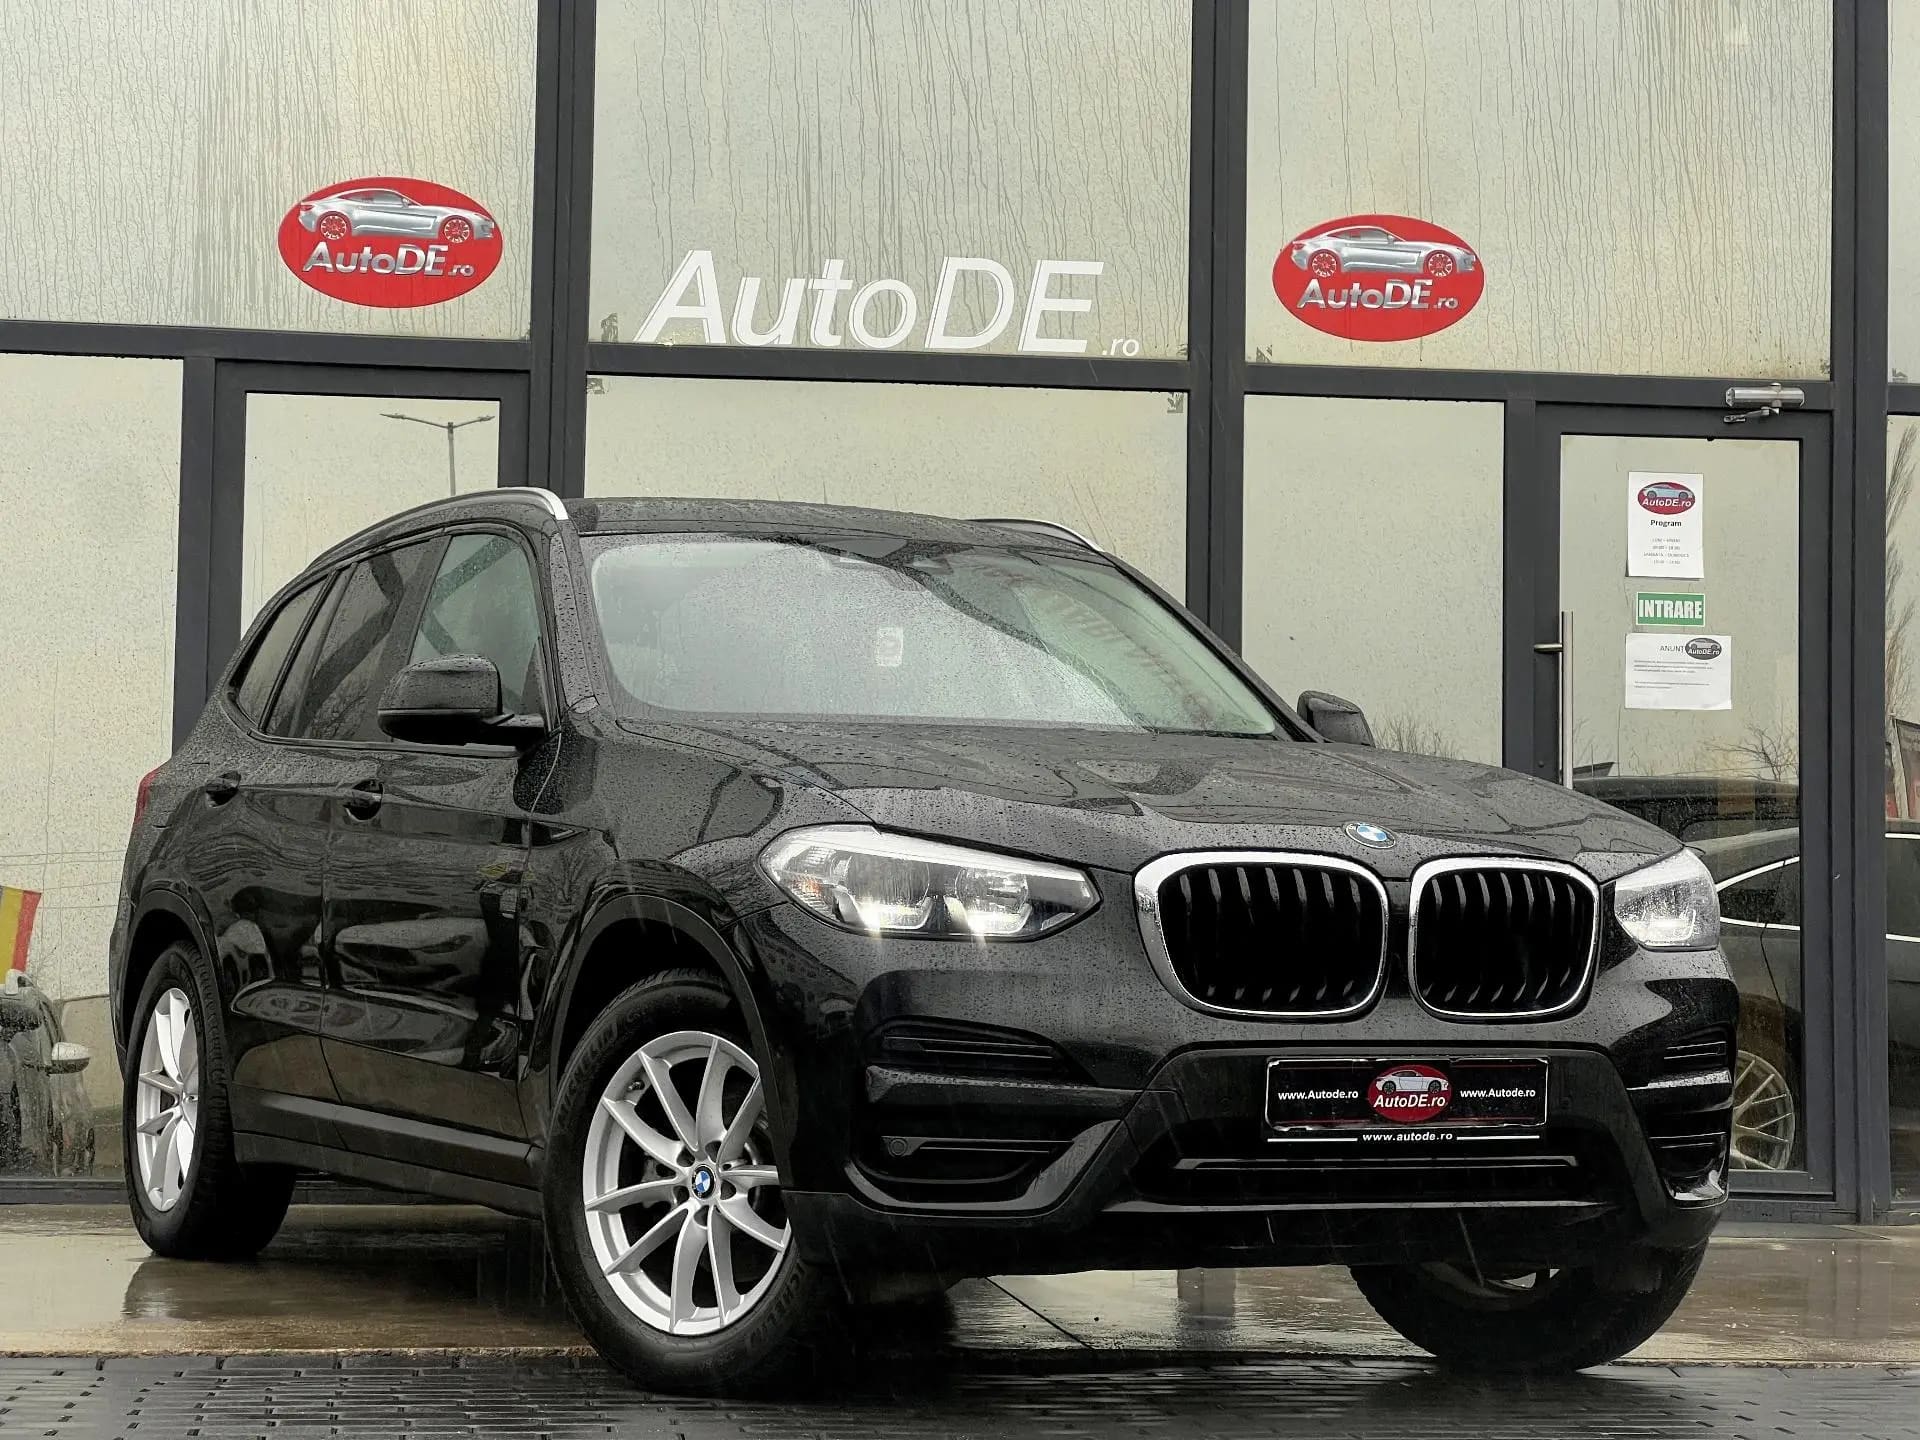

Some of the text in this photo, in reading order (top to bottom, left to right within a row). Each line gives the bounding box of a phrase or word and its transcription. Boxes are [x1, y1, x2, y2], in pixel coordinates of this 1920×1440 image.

[1641, 498, 1692, 508] AutoDE.ro
[1650, 519, 1682, 527] Program
[1638, 599, 1703, 619] INTRARE
[1278, 1089, 1359, 1100] www.Autode.ro
[1460, 1088, 1536, 1098] www.Autode.ro
[1373, 1094, 1446, 1108] AutoDE.ro
[1362, 1131, 1453, 1142] www.autode.ro
